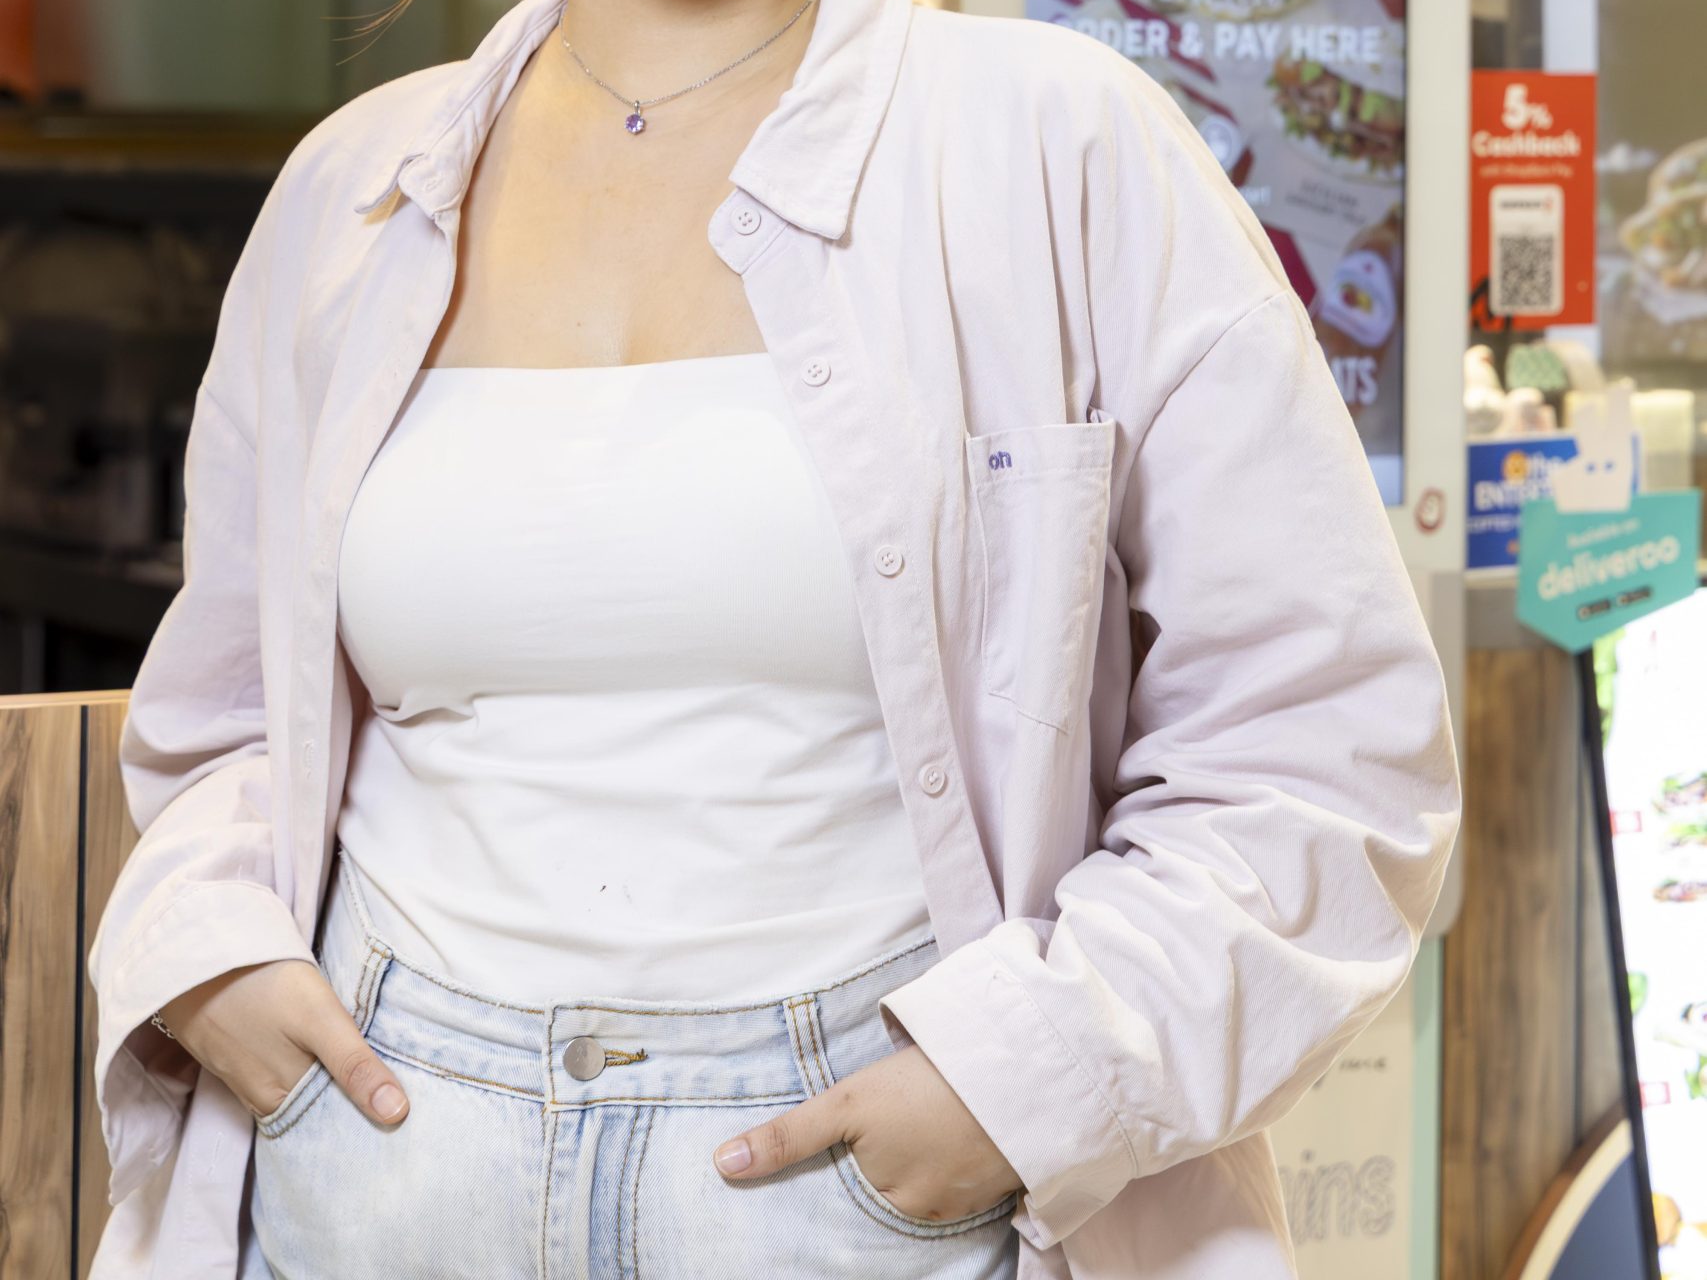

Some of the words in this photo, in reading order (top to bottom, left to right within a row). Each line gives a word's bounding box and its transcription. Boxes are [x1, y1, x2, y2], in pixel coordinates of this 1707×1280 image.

[1177, 20, 1204, 59] &
[1213, 21, 1283, 61] PAY
[1290, 24, 1383, 64] HERE
[1537, 533, 1682, 602] deliveroo
